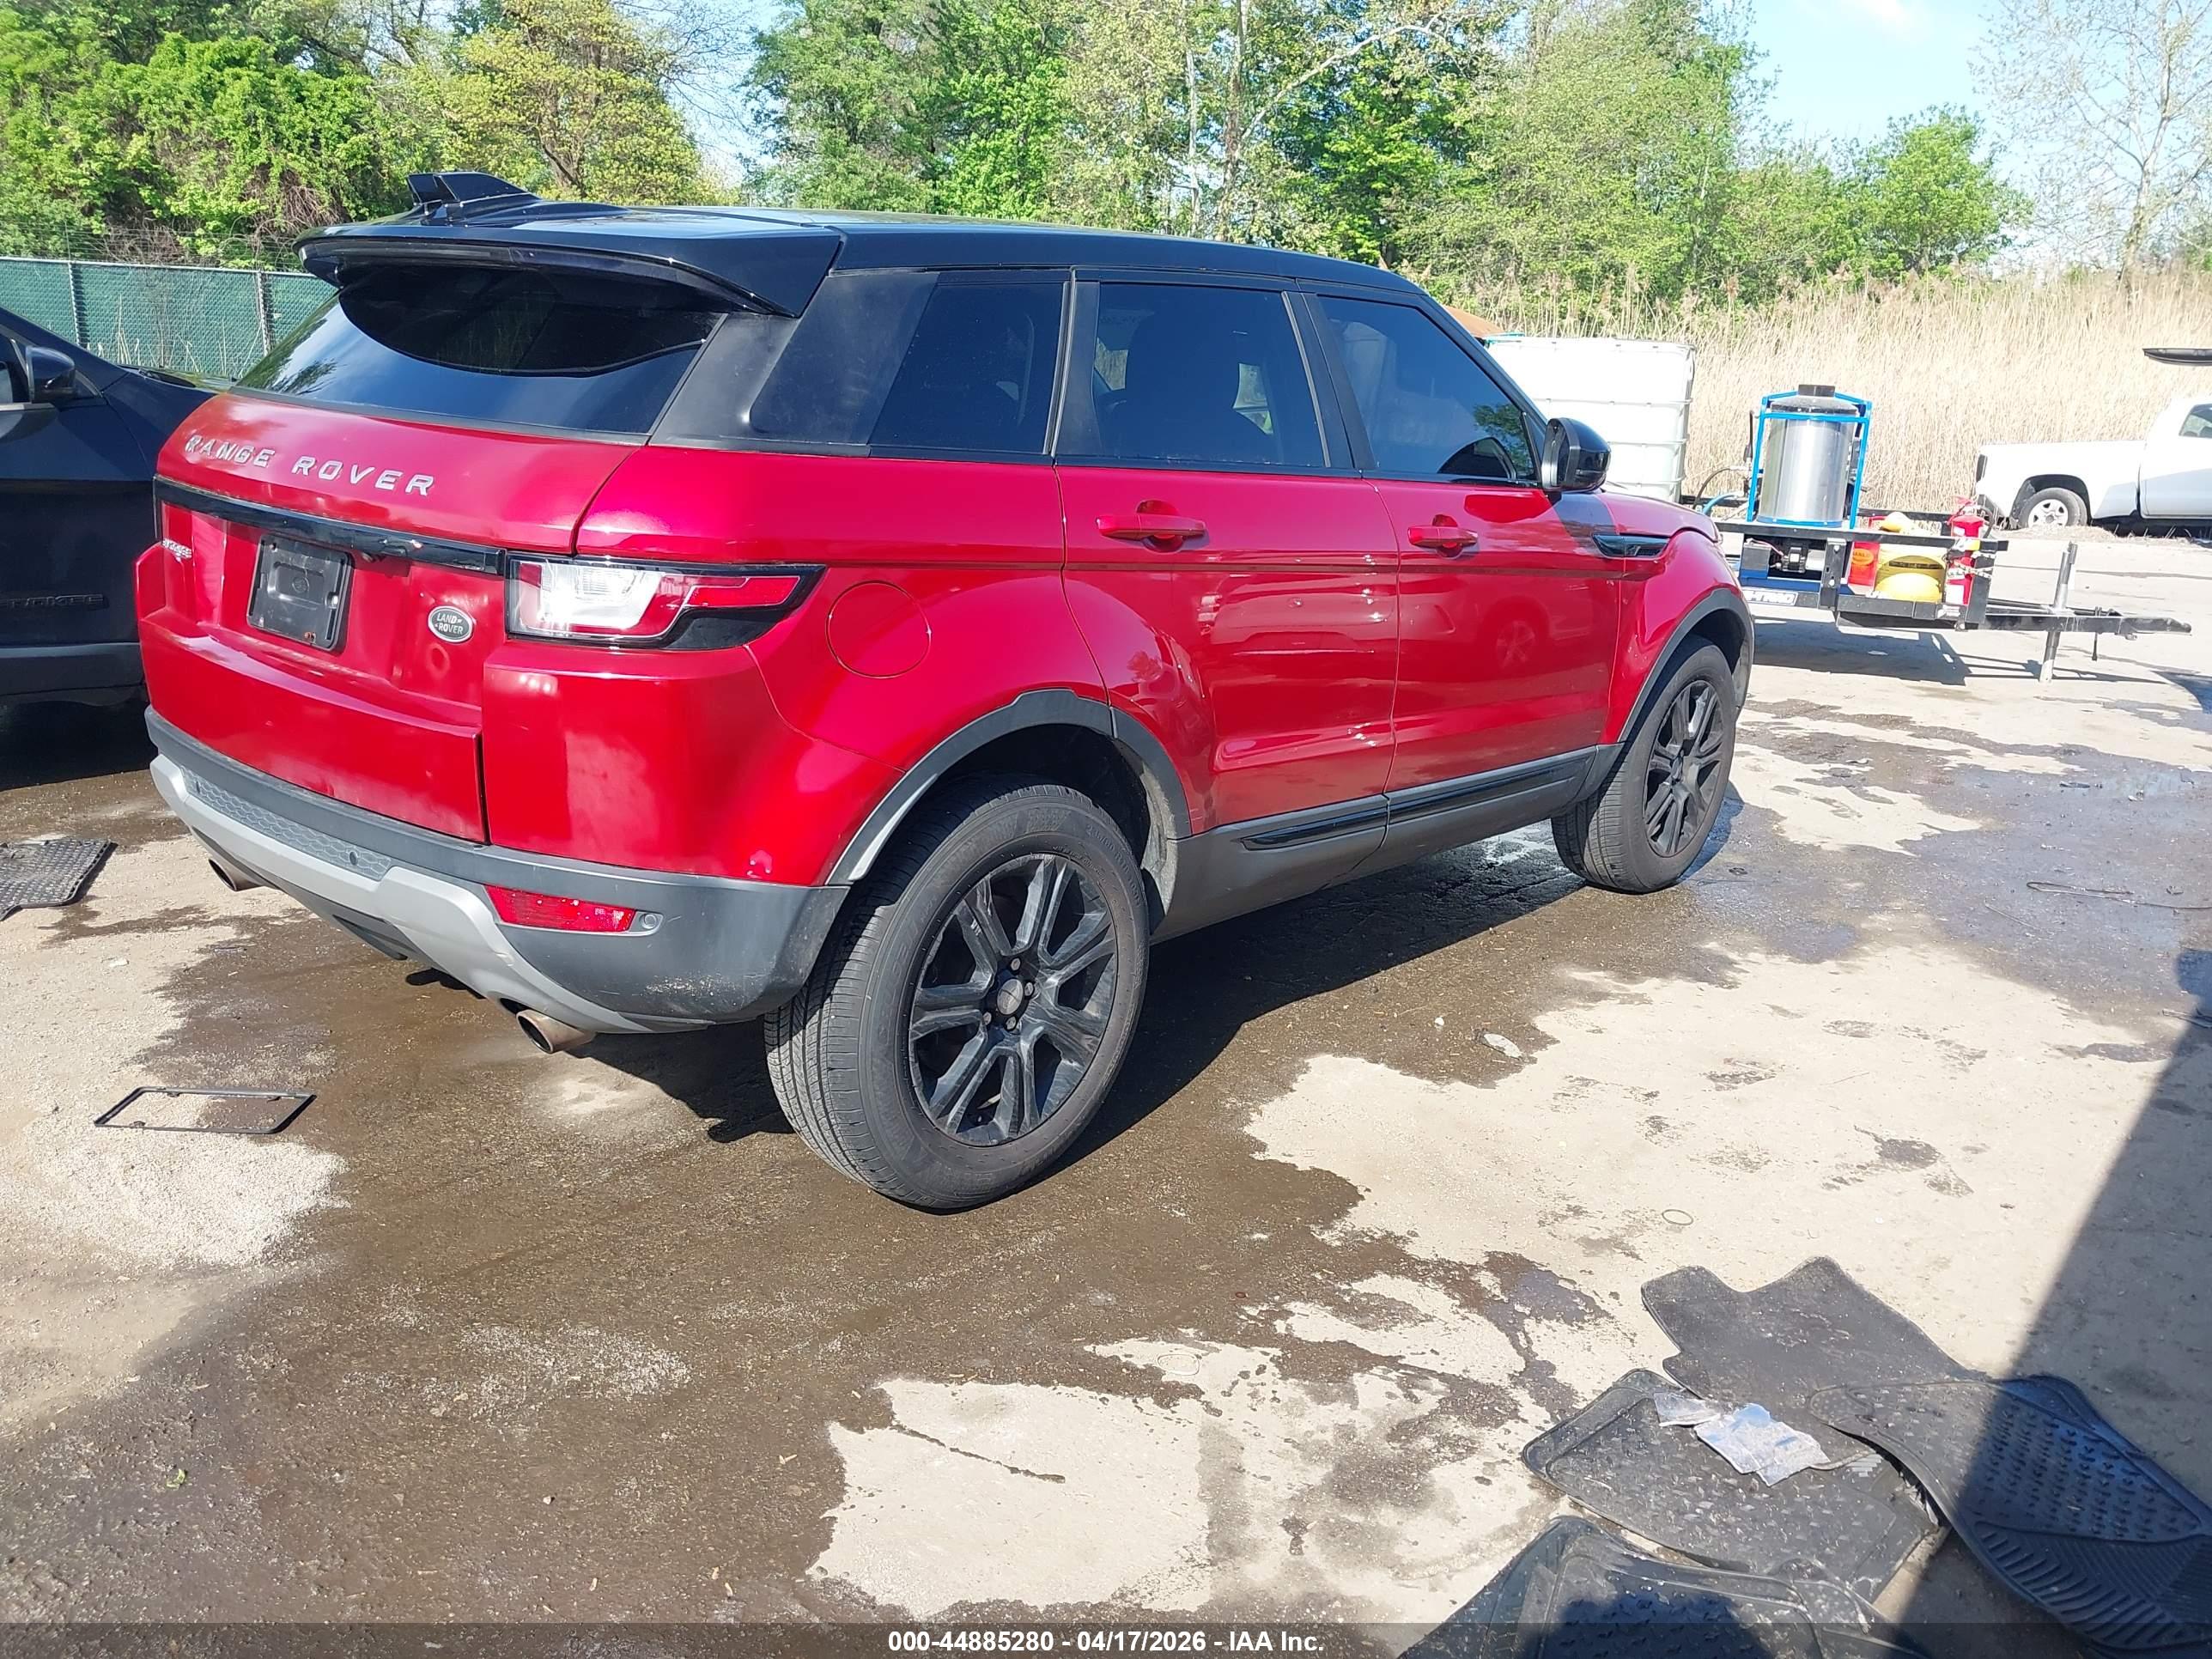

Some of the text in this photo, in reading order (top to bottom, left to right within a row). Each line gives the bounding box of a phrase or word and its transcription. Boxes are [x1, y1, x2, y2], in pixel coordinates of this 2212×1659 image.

[184, 434, 434, 497] RANGE ROVER
[436, 611, 458, 624] LAND
[438, 622, 465, 635] ROVER
